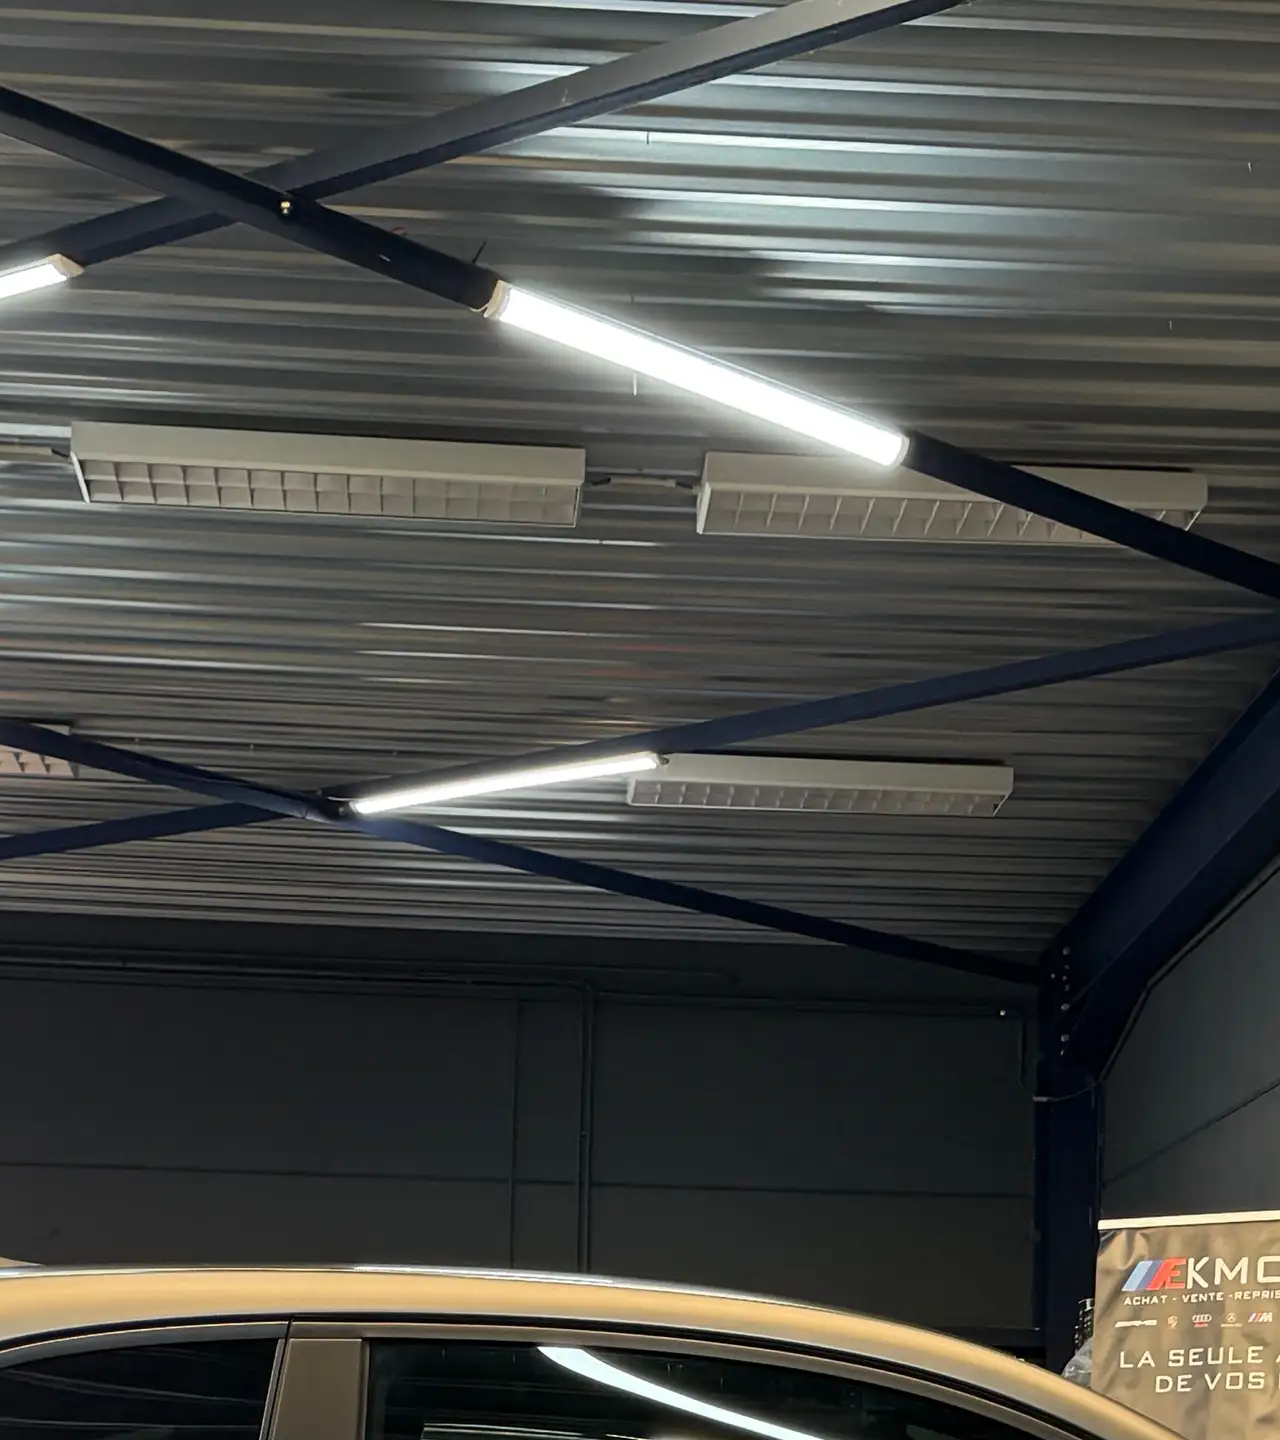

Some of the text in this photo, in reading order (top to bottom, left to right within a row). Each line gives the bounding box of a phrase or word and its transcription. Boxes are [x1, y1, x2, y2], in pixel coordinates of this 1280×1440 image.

[1123, 1295, 1168, 1306] ACHAT
[1182, 1291, 1224, 1303] VENTE
[1120, 1350, 1156, 1369] LA
[1168, 1345, 1264, 1367] SEULE
[1155, 1374, 1192, 1393] DE
[1204, 1371, 1265, 1390] VOS
